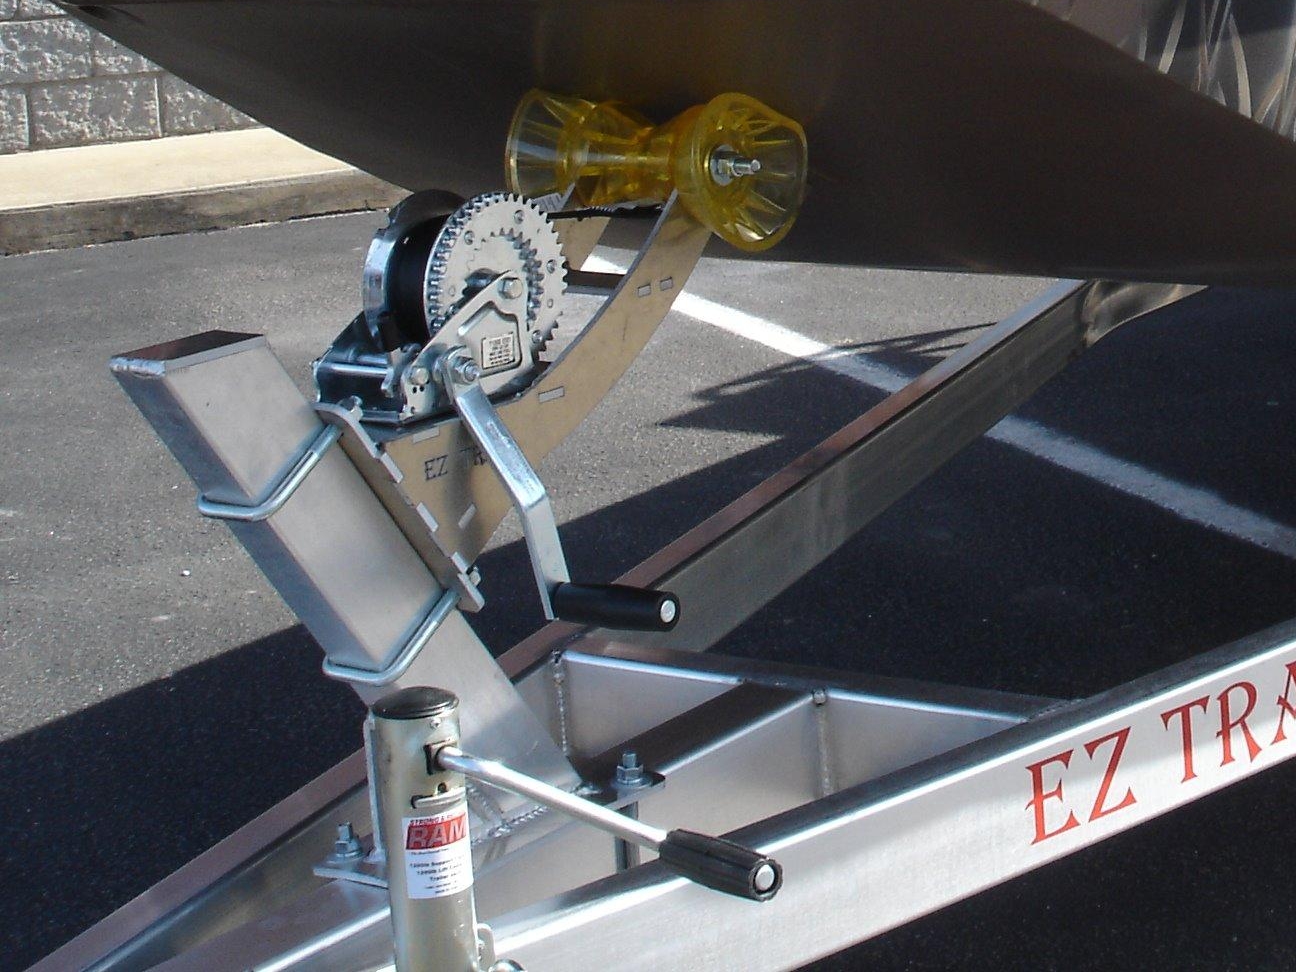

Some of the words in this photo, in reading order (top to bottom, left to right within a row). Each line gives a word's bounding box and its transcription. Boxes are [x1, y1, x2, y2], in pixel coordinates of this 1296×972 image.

[425, 454, 448, 481] EZ
[1025, 726, 1137, 845] EZ
[408, 817, 467, 848] RAM
